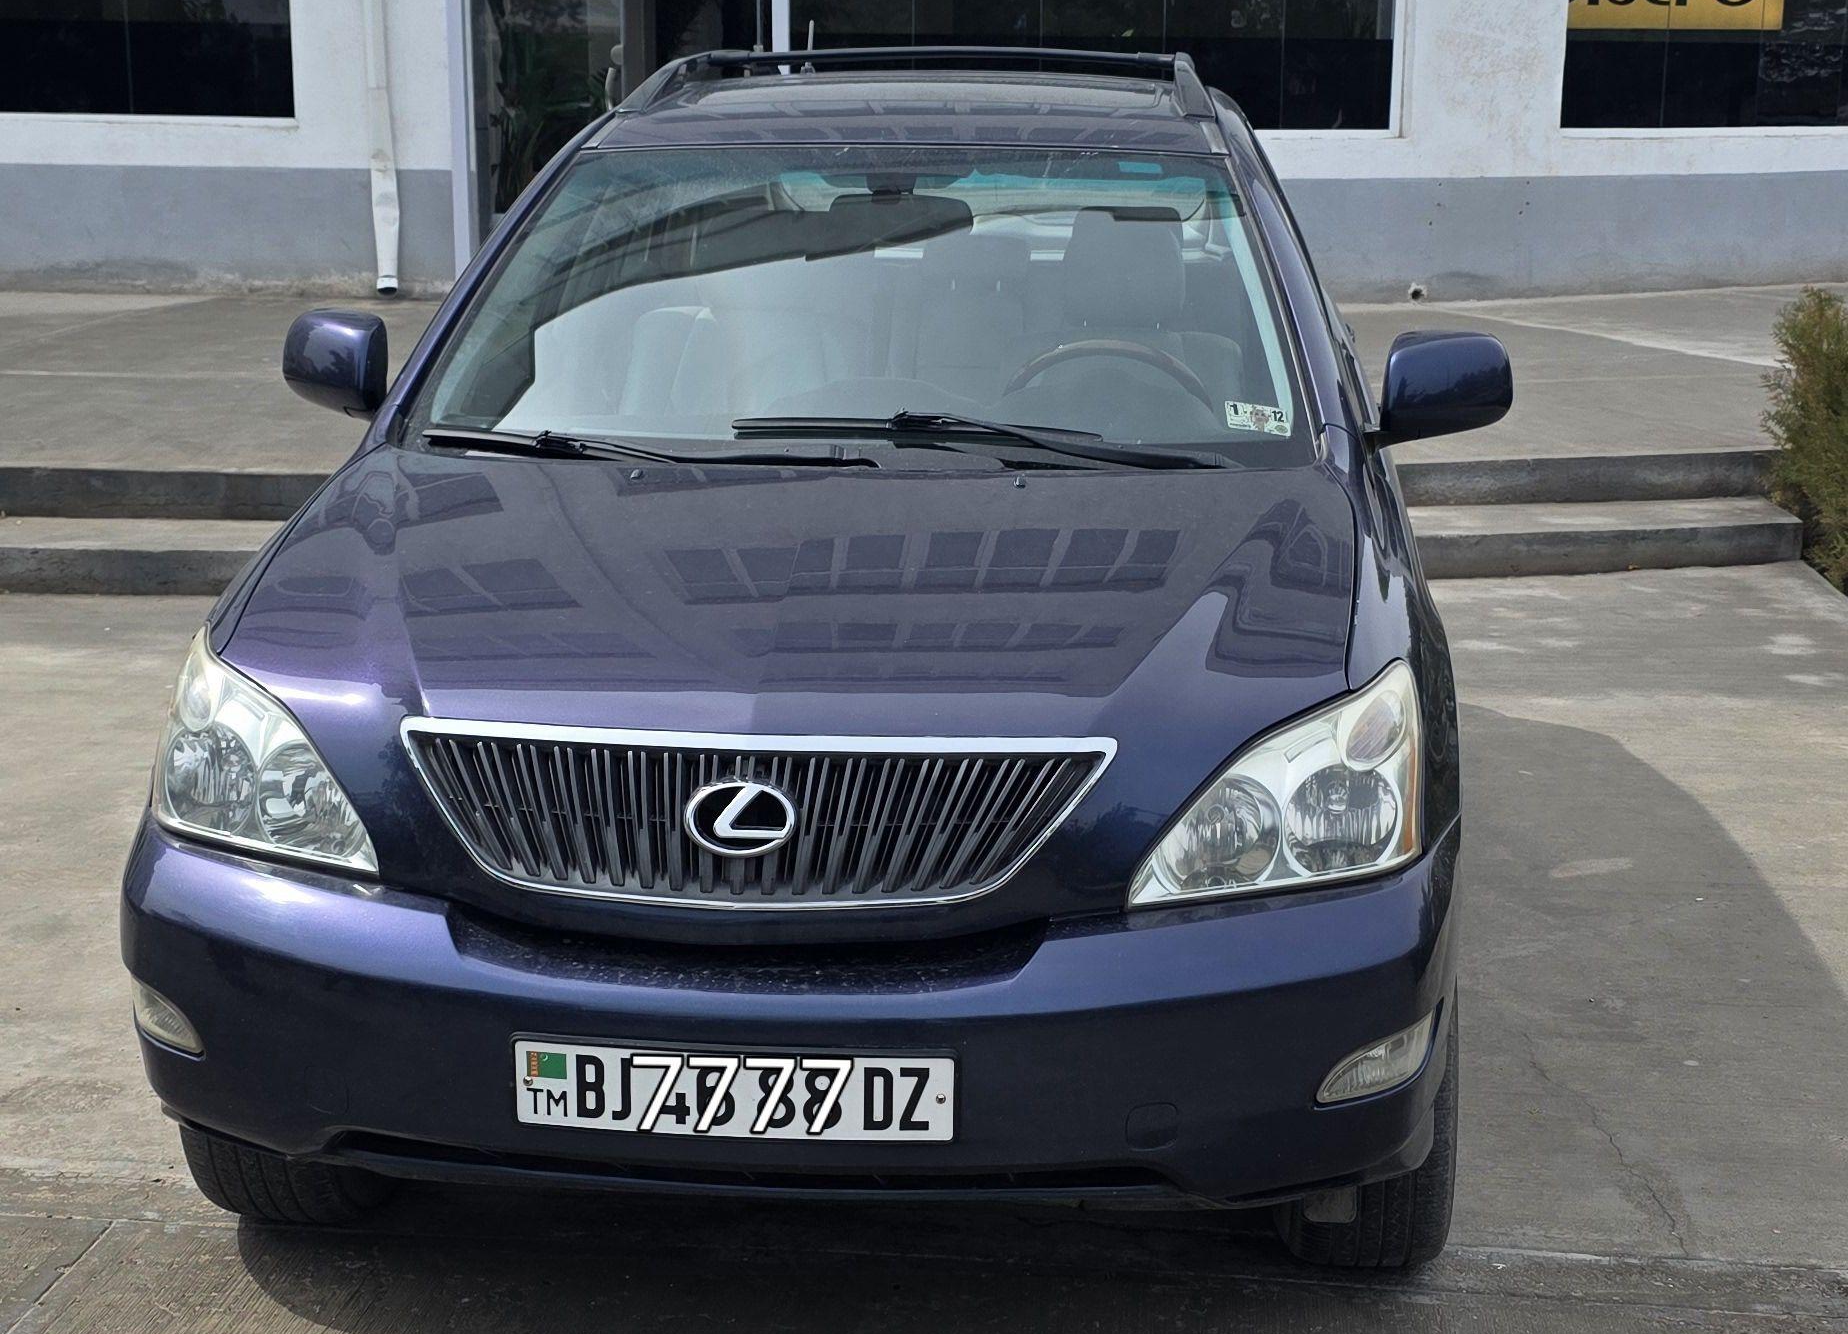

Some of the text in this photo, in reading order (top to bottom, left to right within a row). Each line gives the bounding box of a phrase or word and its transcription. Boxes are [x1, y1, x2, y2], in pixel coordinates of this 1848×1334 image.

[526, 1087, 569, 1118] TM
[575, 1053, 632, 1121] BJ
[863, 1066, 931, 1132] DZ
